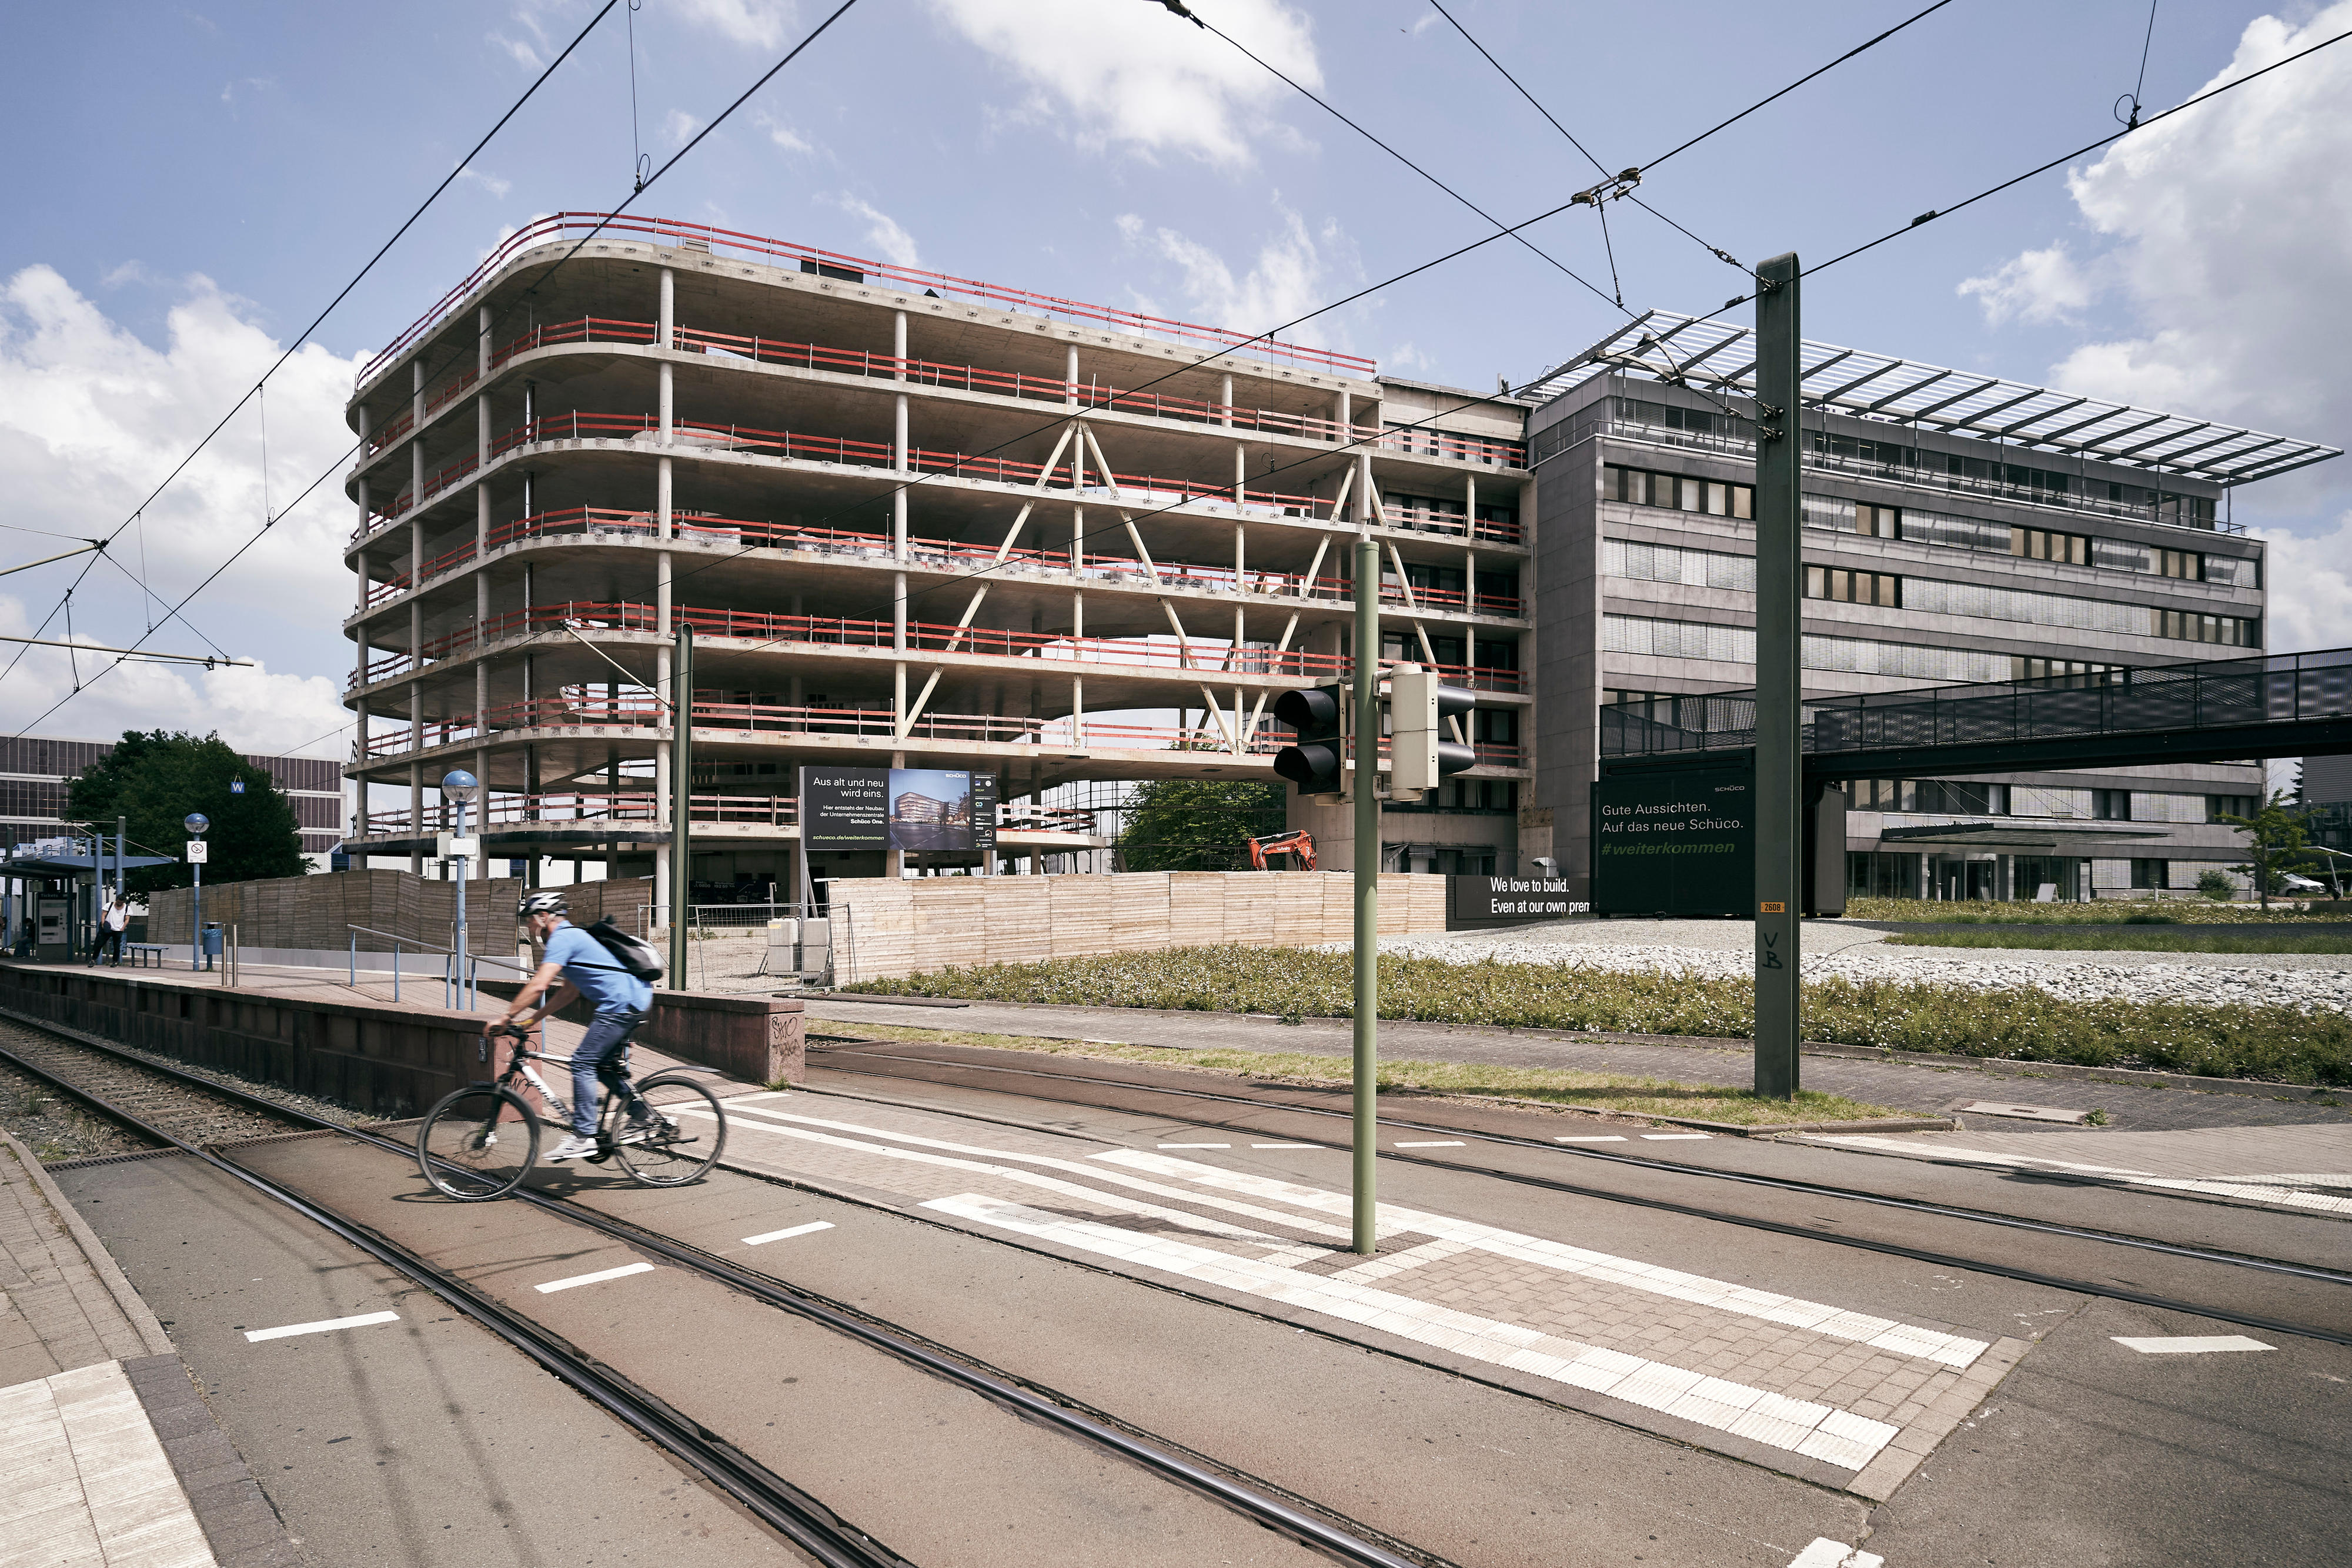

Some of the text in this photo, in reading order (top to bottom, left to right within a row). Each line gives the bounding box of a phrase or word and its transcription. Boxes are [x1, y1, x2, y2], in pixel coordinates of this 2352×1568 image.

[233, 783, 243, 791] W
[813, 777, 831, 786] Aus
[834, 778, 845, 786] alt
[847, 778, 864, 787] und
[841, 789, 884, 798] wird eins.
[1602, 802, 1710, 815] Gute Aussichten.
[1602, 818, 1744, 833] Auf das neue Schüco.
[1602, 842, 1735, 855] #weiterkommen
[1491, 877, 1569, 892] We love to build.
[1491, 898, 1515, 914] Even
[1518, 900, 1527, 914] at
[1529, 902, 1544, 913] our
[1546, 902, 1566, 913] own
